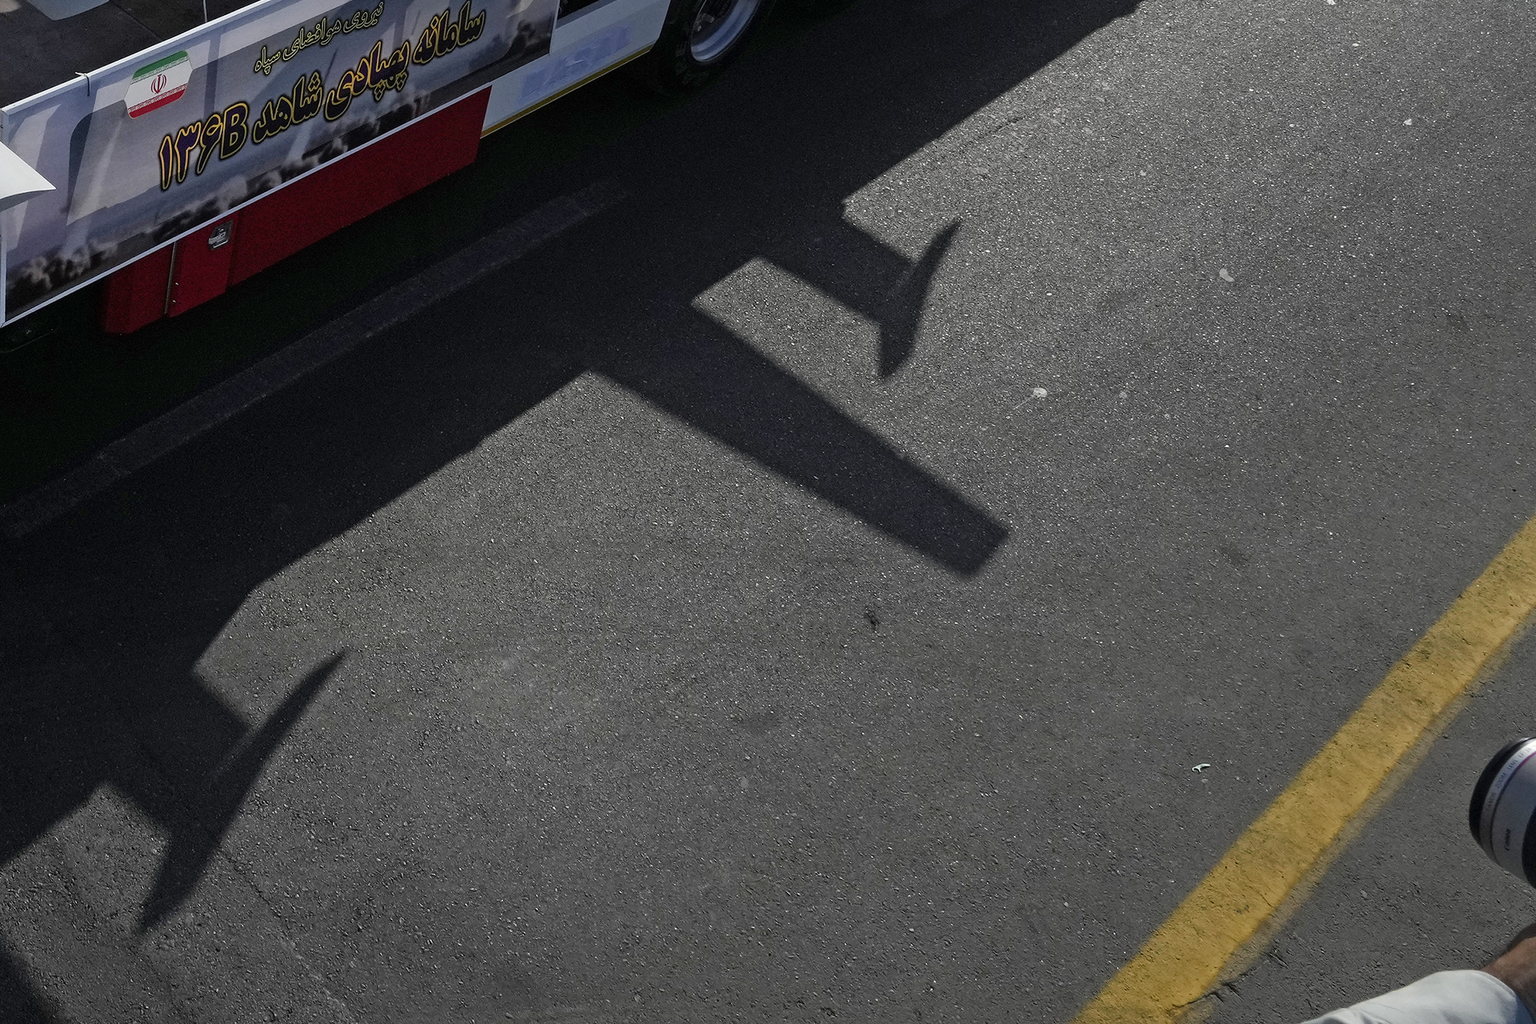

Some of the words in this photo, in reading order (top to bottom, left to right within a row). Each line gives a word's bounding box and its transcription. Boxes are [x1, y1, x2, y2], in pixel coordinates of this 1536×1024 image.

[343, 1, 385, 33] نیروی
[412, 0, 486, 65] سامانه
[254, 46, 281, 75] سپاه
[324, 40, 410, 121] پهپادی
[253, 73, 324, 144] شاهد
